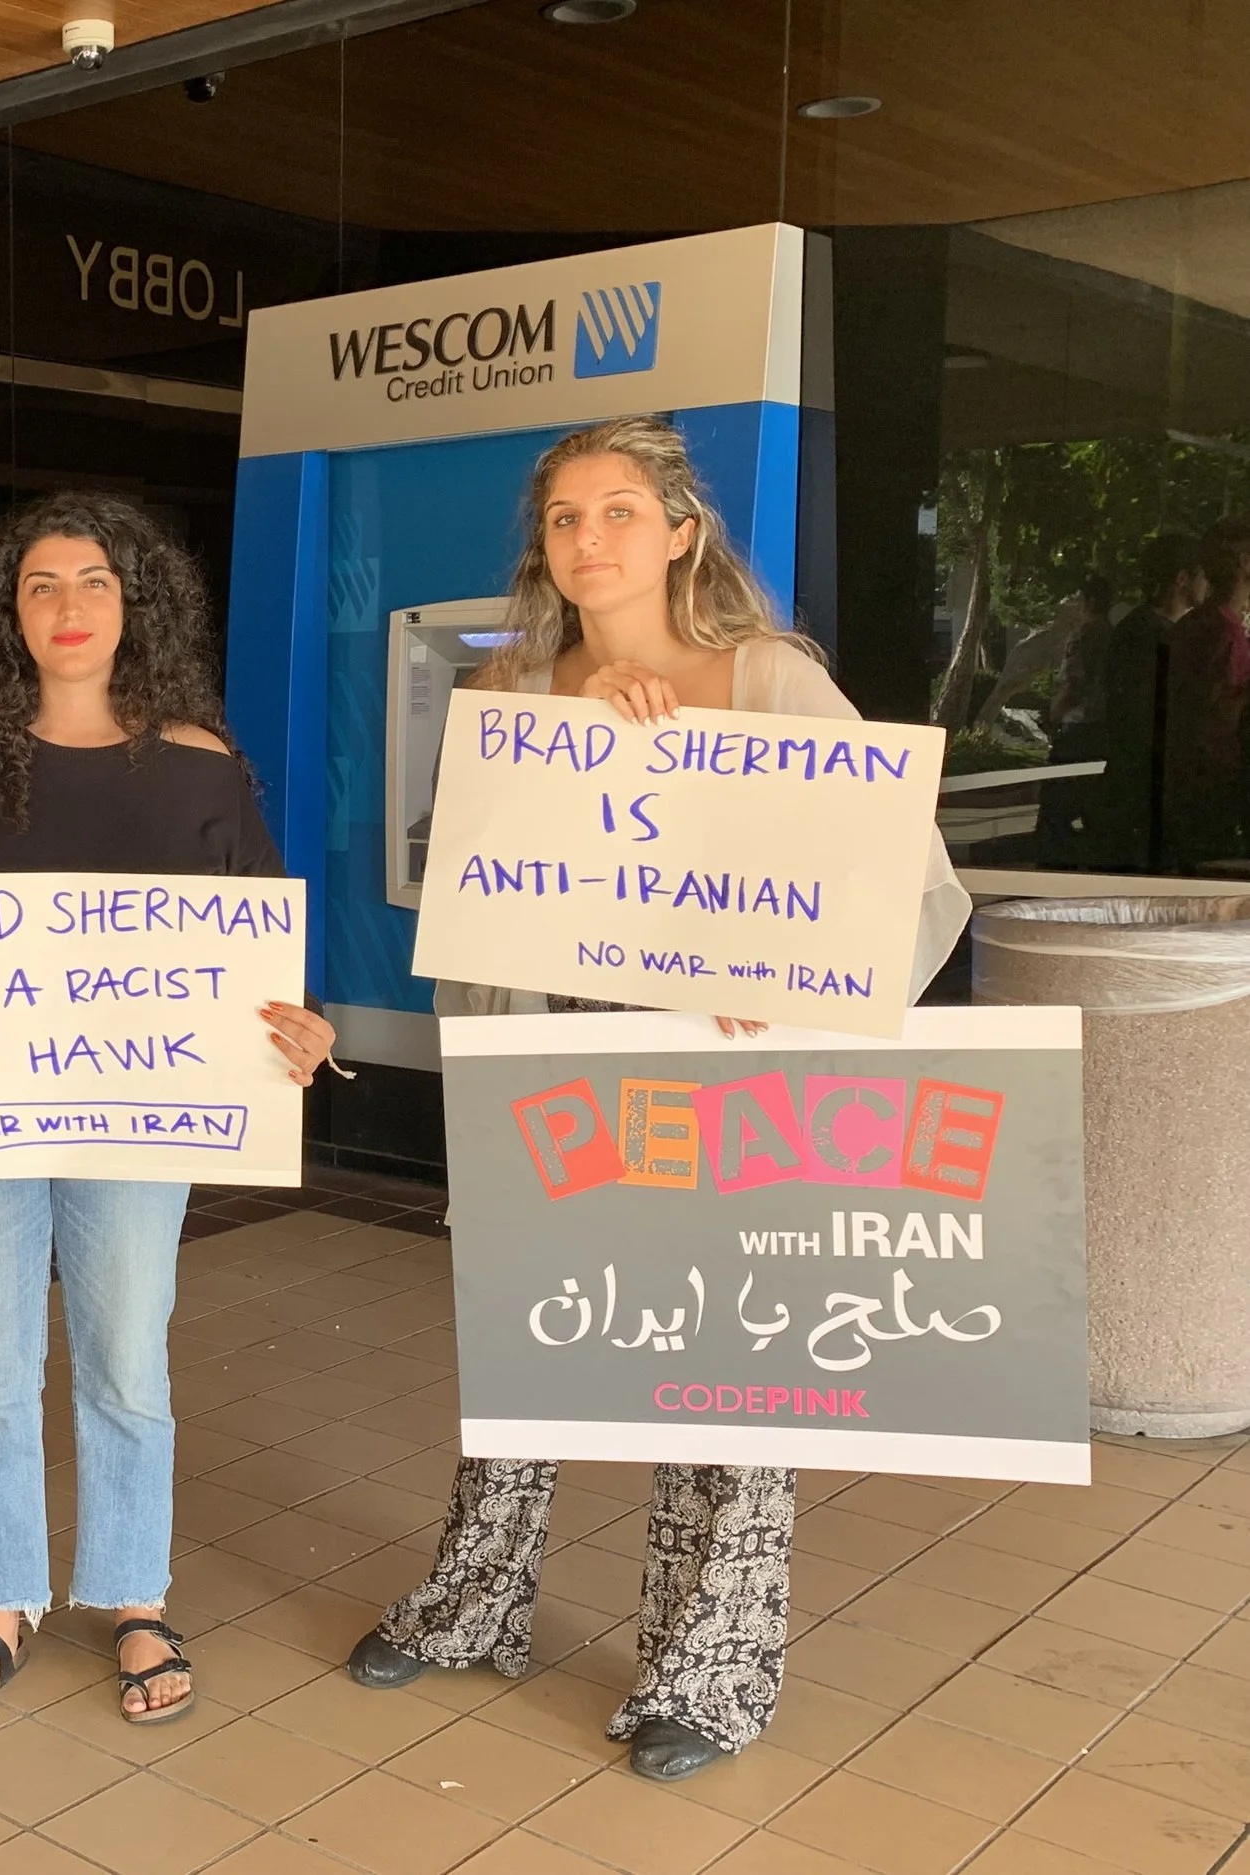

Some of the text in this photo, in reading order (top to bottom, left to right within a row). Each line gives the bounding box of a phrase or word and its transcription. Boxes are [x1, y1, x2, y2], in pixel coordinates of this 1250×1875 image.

[329, 299, 556, 381] WESCOM
[386, 361, 554, 402] Credit Union
[477, 708, 912, 783] BRAD SHERMAN
[602, 793, 661, 842] IS
[47, 886, 293, 939] SHERMAN
[458, 854, 821, 923] ANTI-IRANIAN
[3, 967, 44, 1009] A
[66, 965, 228, 1003] RACIST
[578, 941, 874, 999] NO WAR with IRAN
[28, 1031, 208, 1077] HAWK
[34, 1113, 111, 1135] WITH
[130, 1111, 234, 1139] IRAN
[512, 1074, 1003, 1199] PEACE
[738, 1210, 985, 1261] WITH IRAN
[528, 1262, 1003, 1373] صلح با ایران
[653, 1382, 871, 1419] CODEPINK
